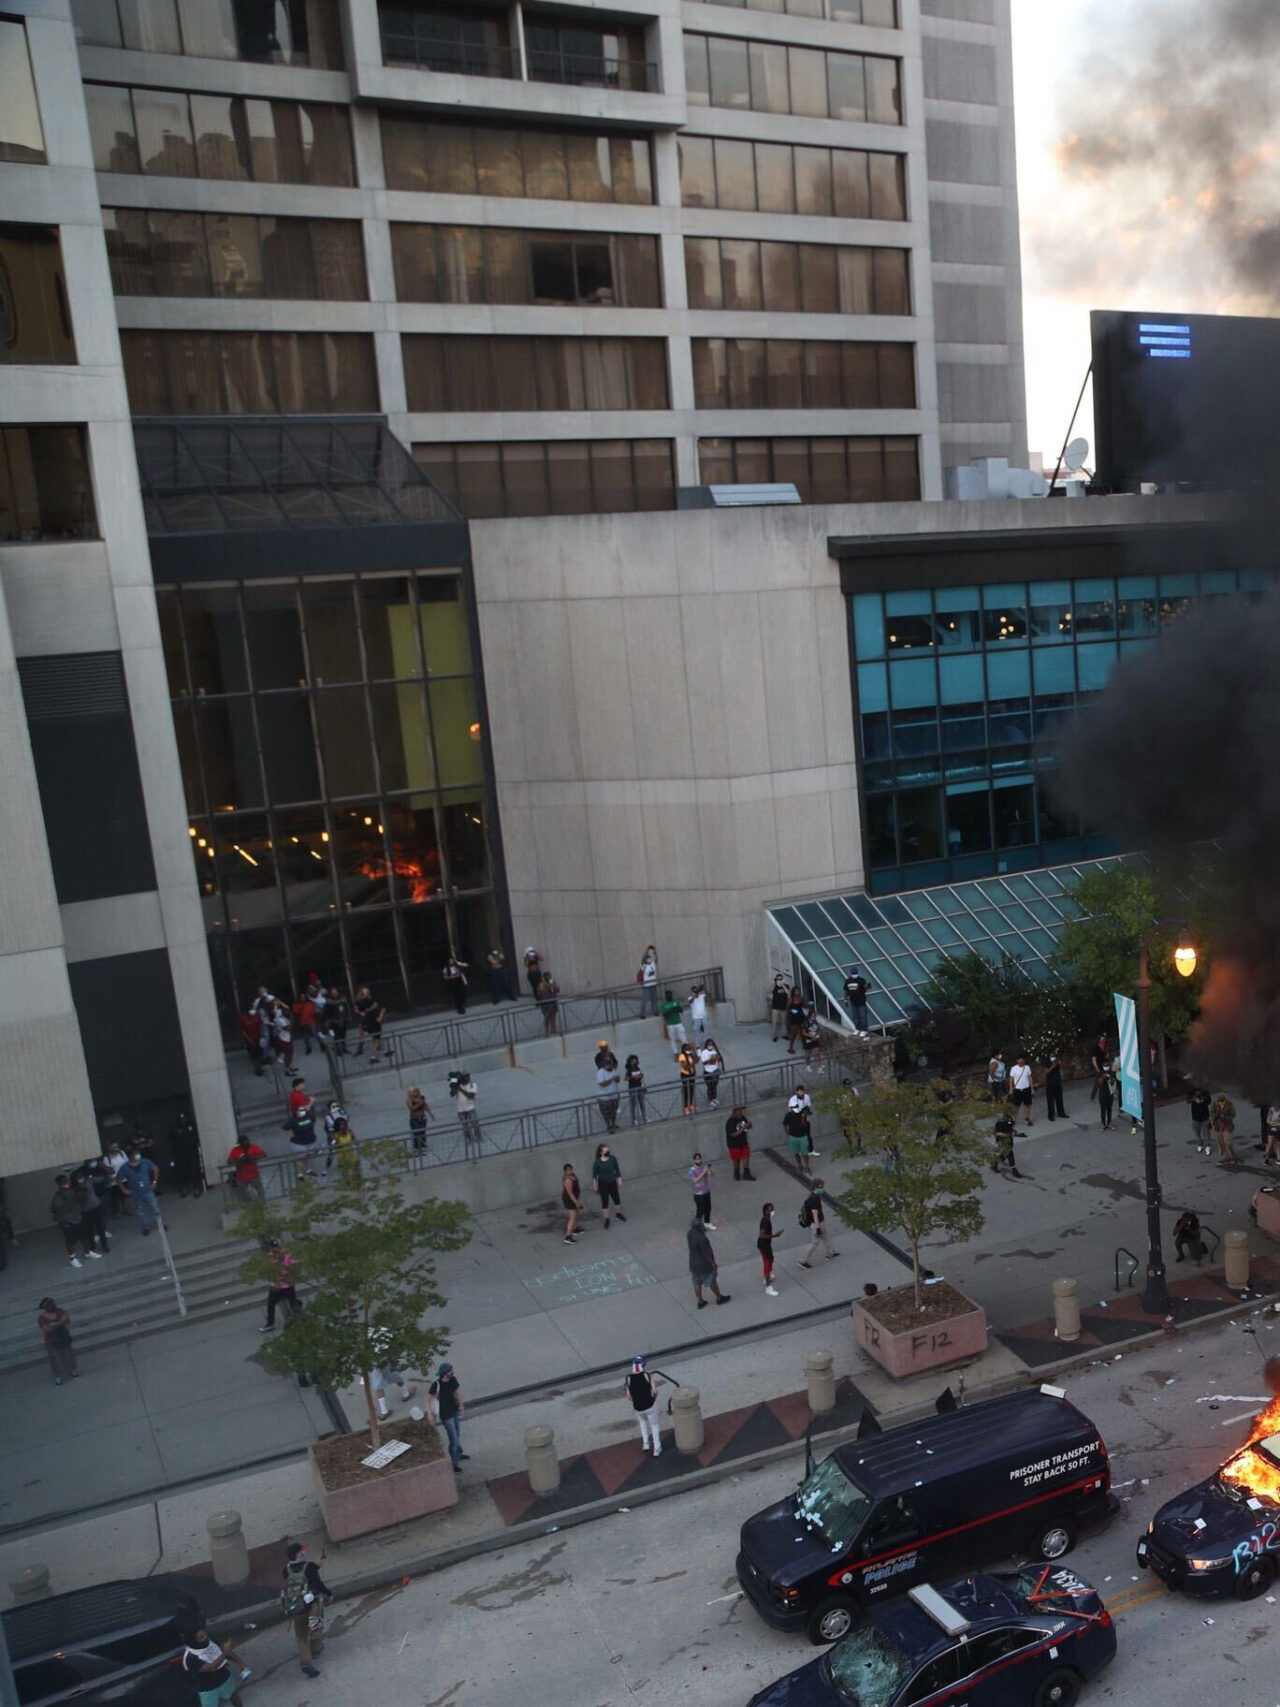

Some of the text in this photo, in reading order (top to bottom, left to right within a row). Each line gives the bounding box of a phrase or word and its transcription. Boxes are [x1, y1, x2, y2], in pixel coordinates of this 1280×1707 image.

[912, 1332, 952, 1358] F12
[1009, 1441, 1100, 1481] PRISONER TRANSPORT
[1024, 1456, 1091, 1487] STAY BACK 50 FT.
[864, 1556, 918, 1586] POLICE
